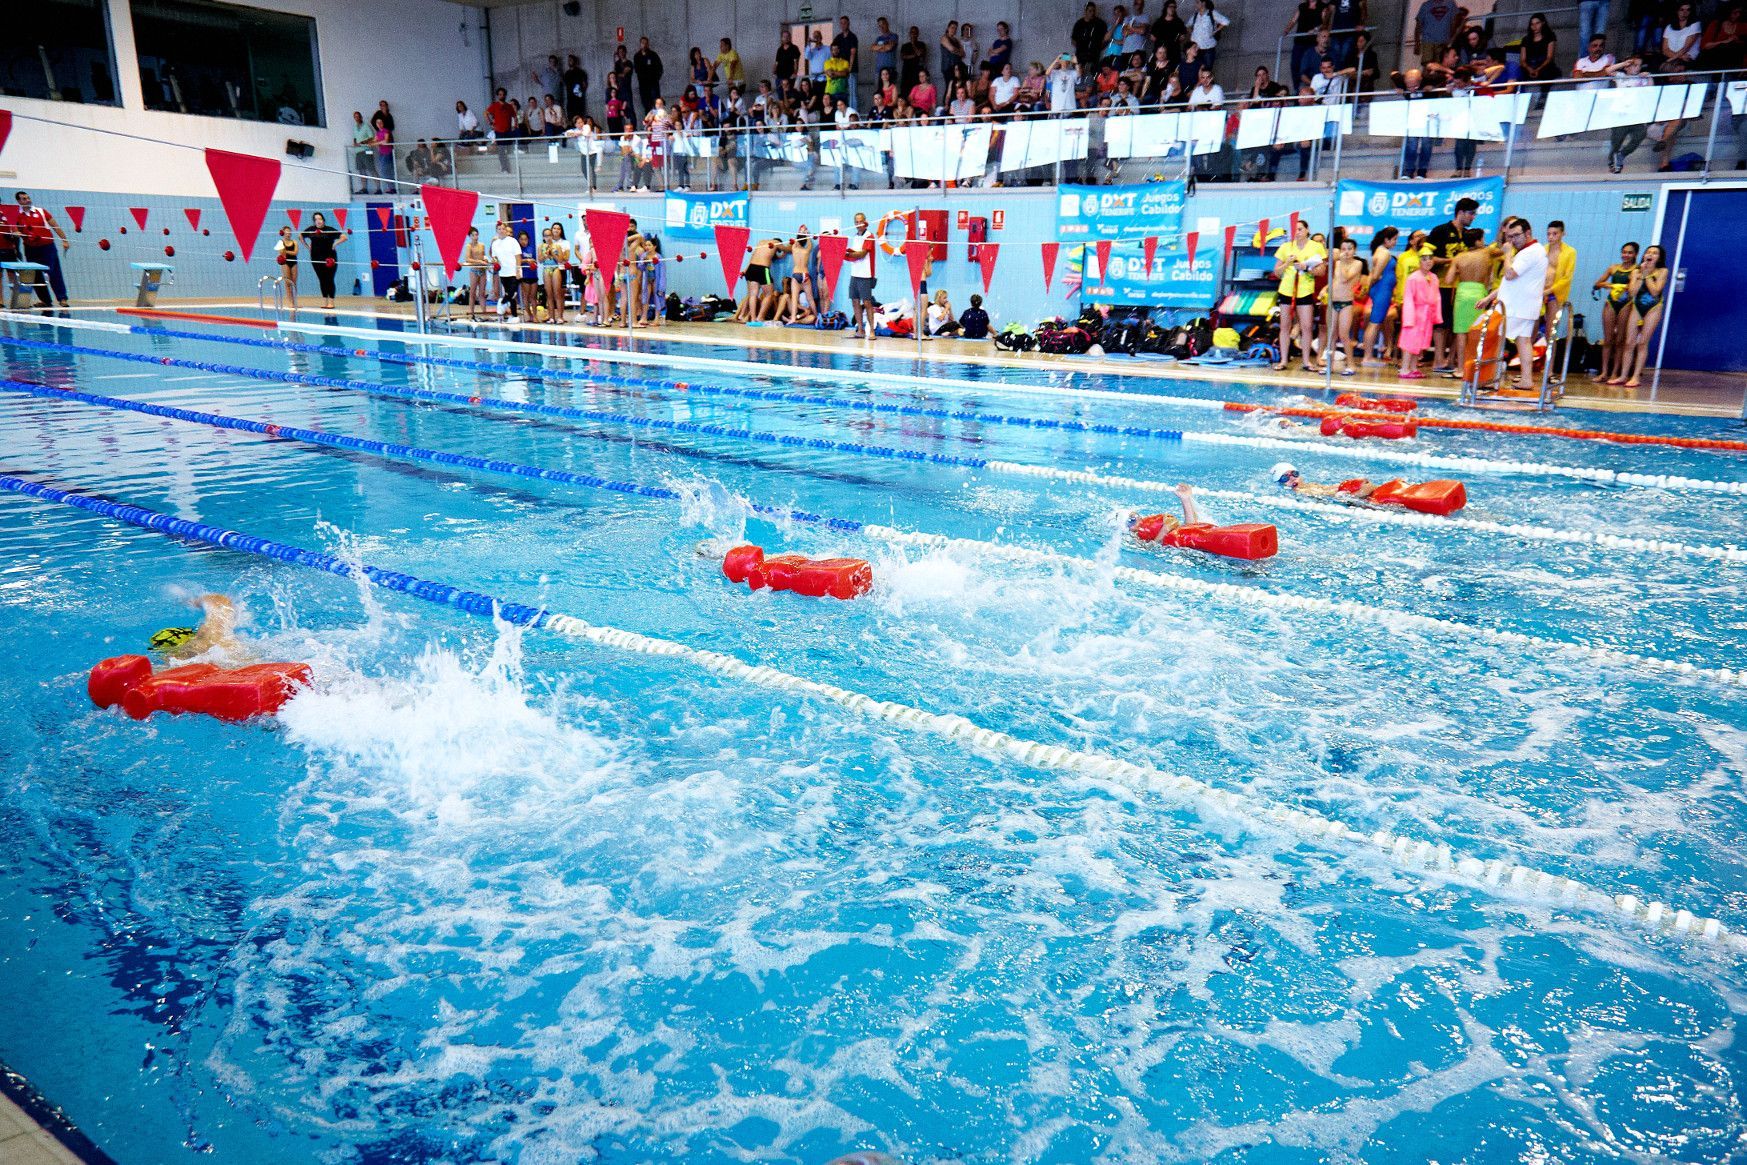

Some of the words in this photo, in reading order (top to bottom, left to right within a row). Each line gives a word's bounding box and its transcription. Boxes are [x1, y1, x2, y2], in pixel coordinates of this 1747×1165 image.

[1101, 193, 1138, 207] DXT
[1142, 193, 1180, 204] Juegos
[1392, 191, 1439, 207] DXT
[710, 200, 748, 219] DXT
[1141, 203, 1181, 215] Cabildo
[1391, 208, 1436, 217] TENERIFE
[1171, 270, 1214, 281] Cabildo
